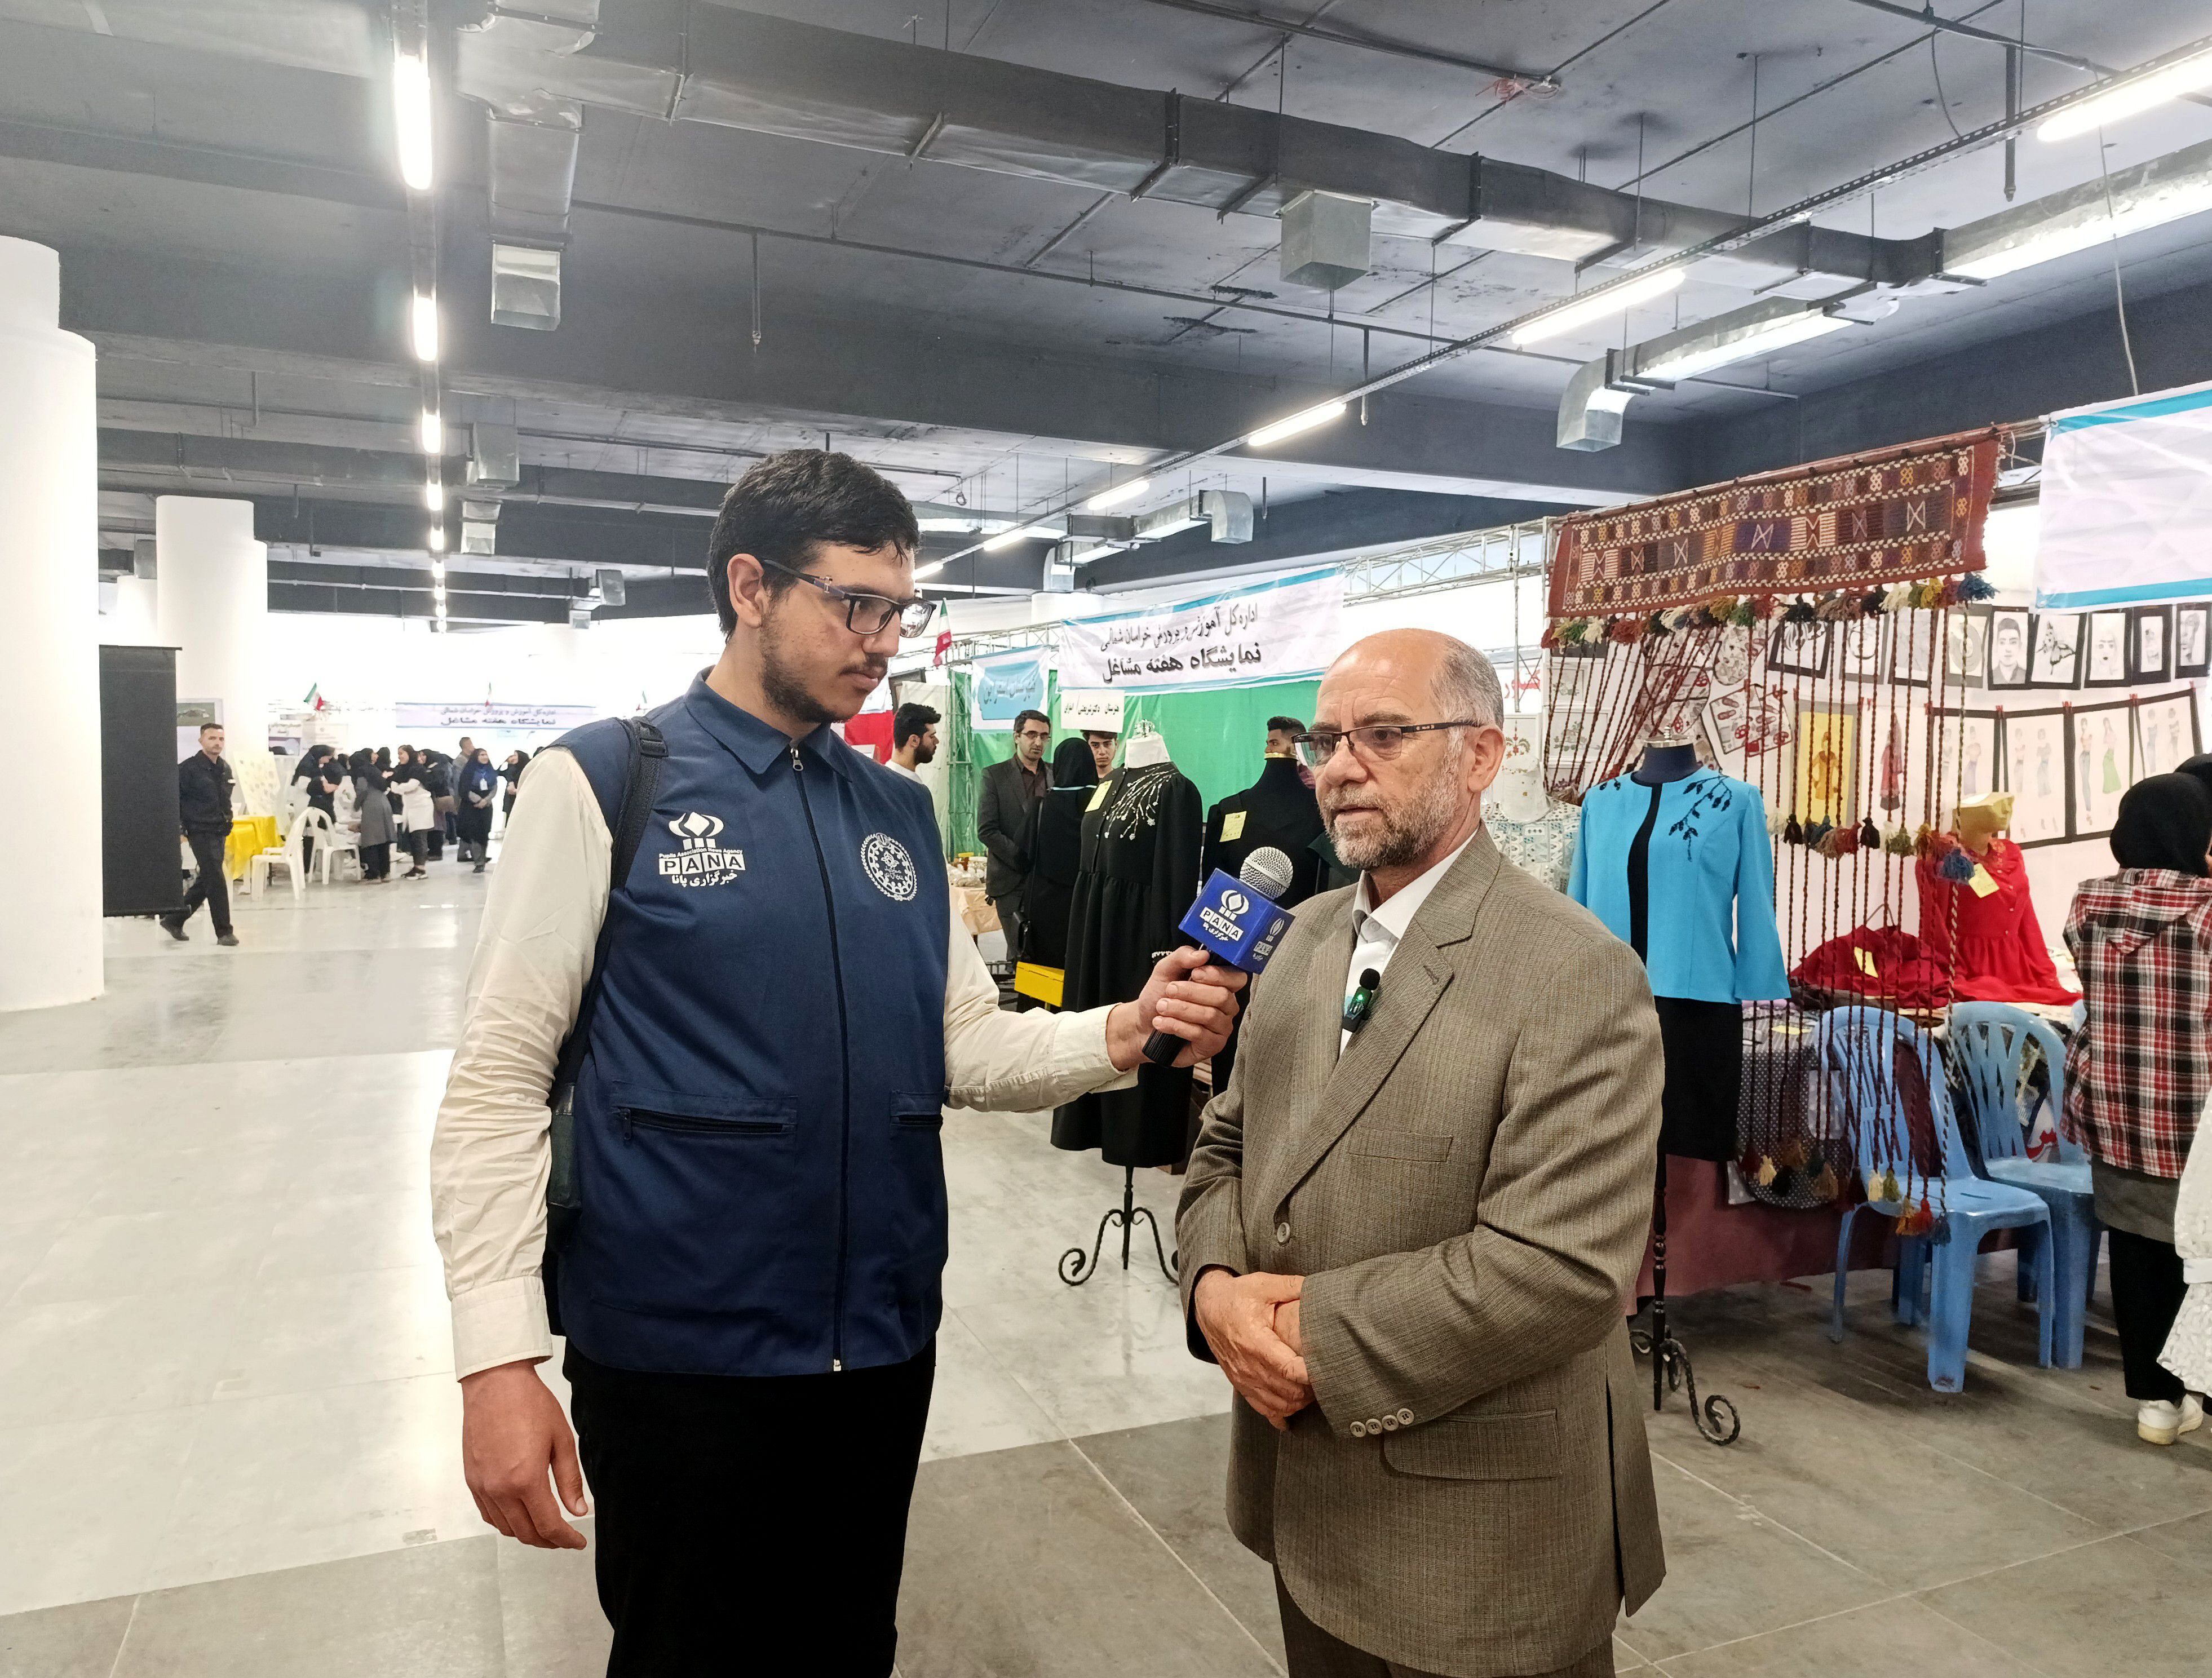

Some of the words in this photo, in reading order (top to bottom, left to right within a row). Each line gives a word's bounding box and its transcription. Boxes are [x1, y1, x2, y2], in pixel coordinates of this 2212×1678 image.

[1186, 605, 1222, 641] آموزش
[1224, 603, 1240, 636] کل
[1238, 602, 1258, 630] اداره
[1100, 627, 1124, 652] شمالی
[1124, 625, 1151, 648] خراسان
[1103, 656, 1142, 684] مشاغل
[1145, 654, 1184, 674] هفته
[1190, 641, 1262, 673] نمایشگاه
[661, 853, 745, 874] PANA
[677, 847, 707, 858] Association
[671, 874, 688, 888] پانا
[1201, 908, 1242, 940] PANA
